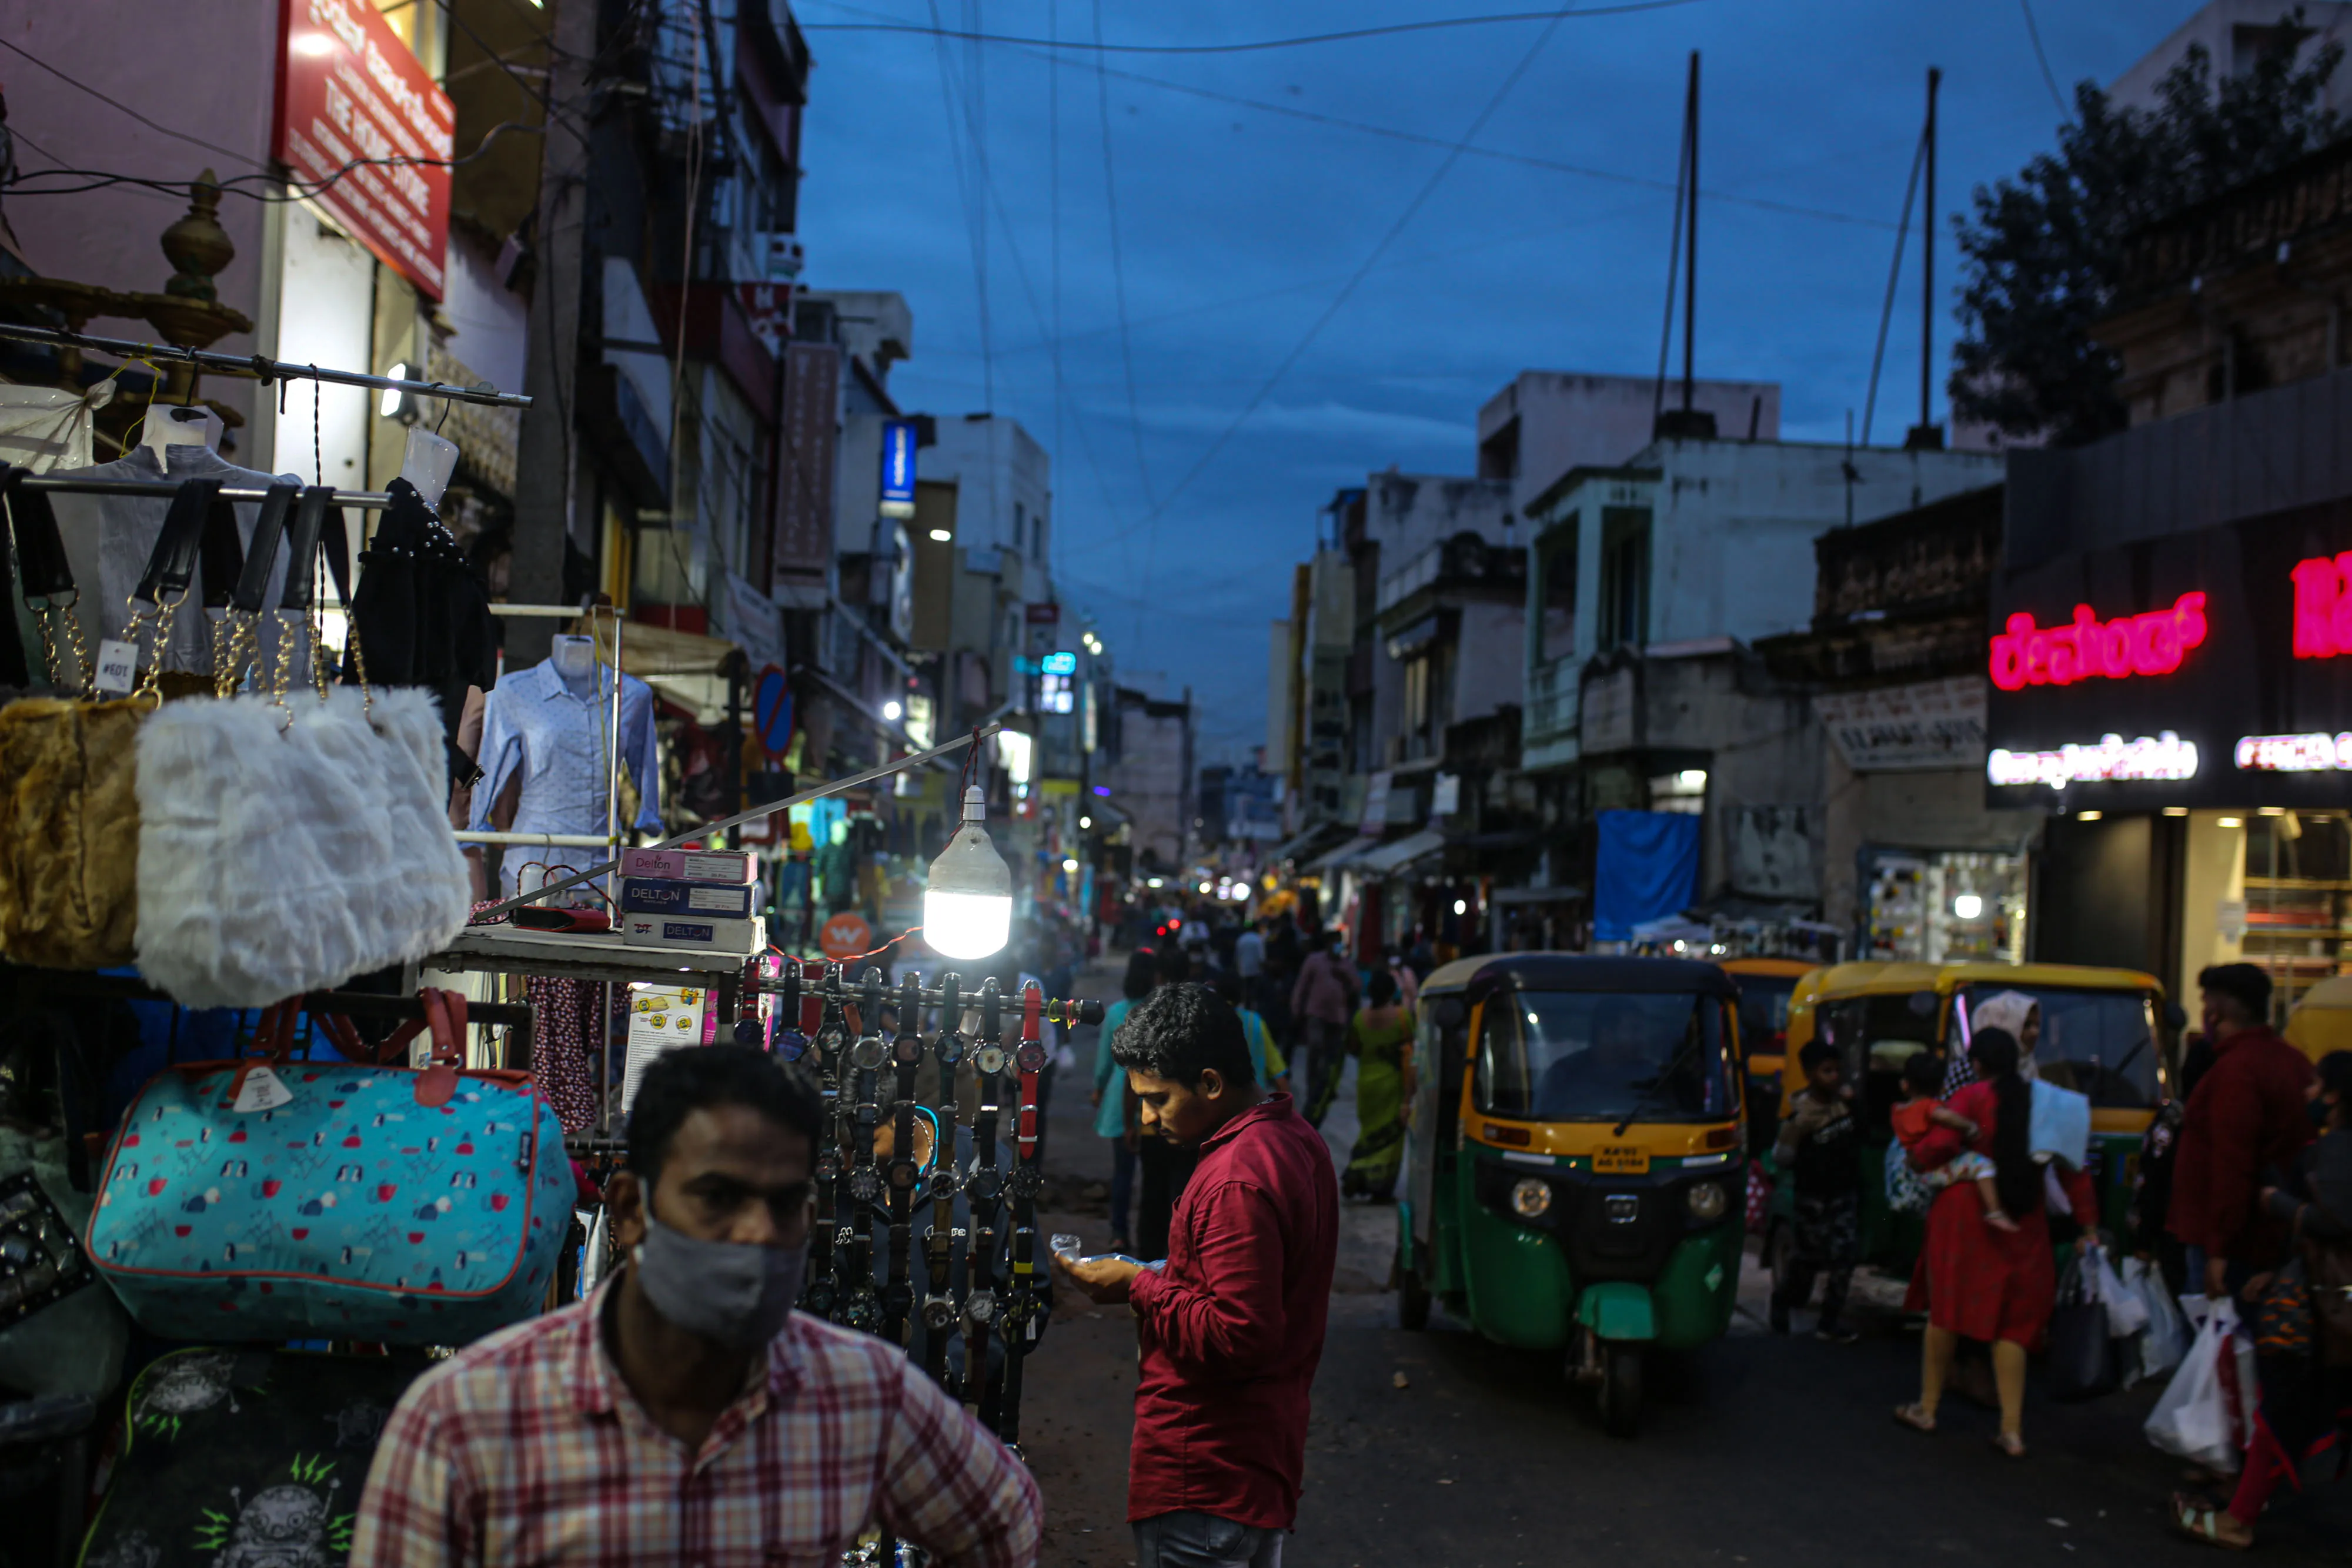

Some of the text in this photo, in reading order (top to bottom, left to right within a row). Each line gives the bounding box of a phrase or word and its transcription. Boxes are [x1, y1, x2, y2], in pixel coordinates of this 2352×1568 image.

[325, 76, 353, 135] THE
[352, 107, 393, 178] HOME
[636, 857, 670, 870] Delton
[631, 887, 680, 901] DELTON
[667, 925, 710, 937] DELTON
